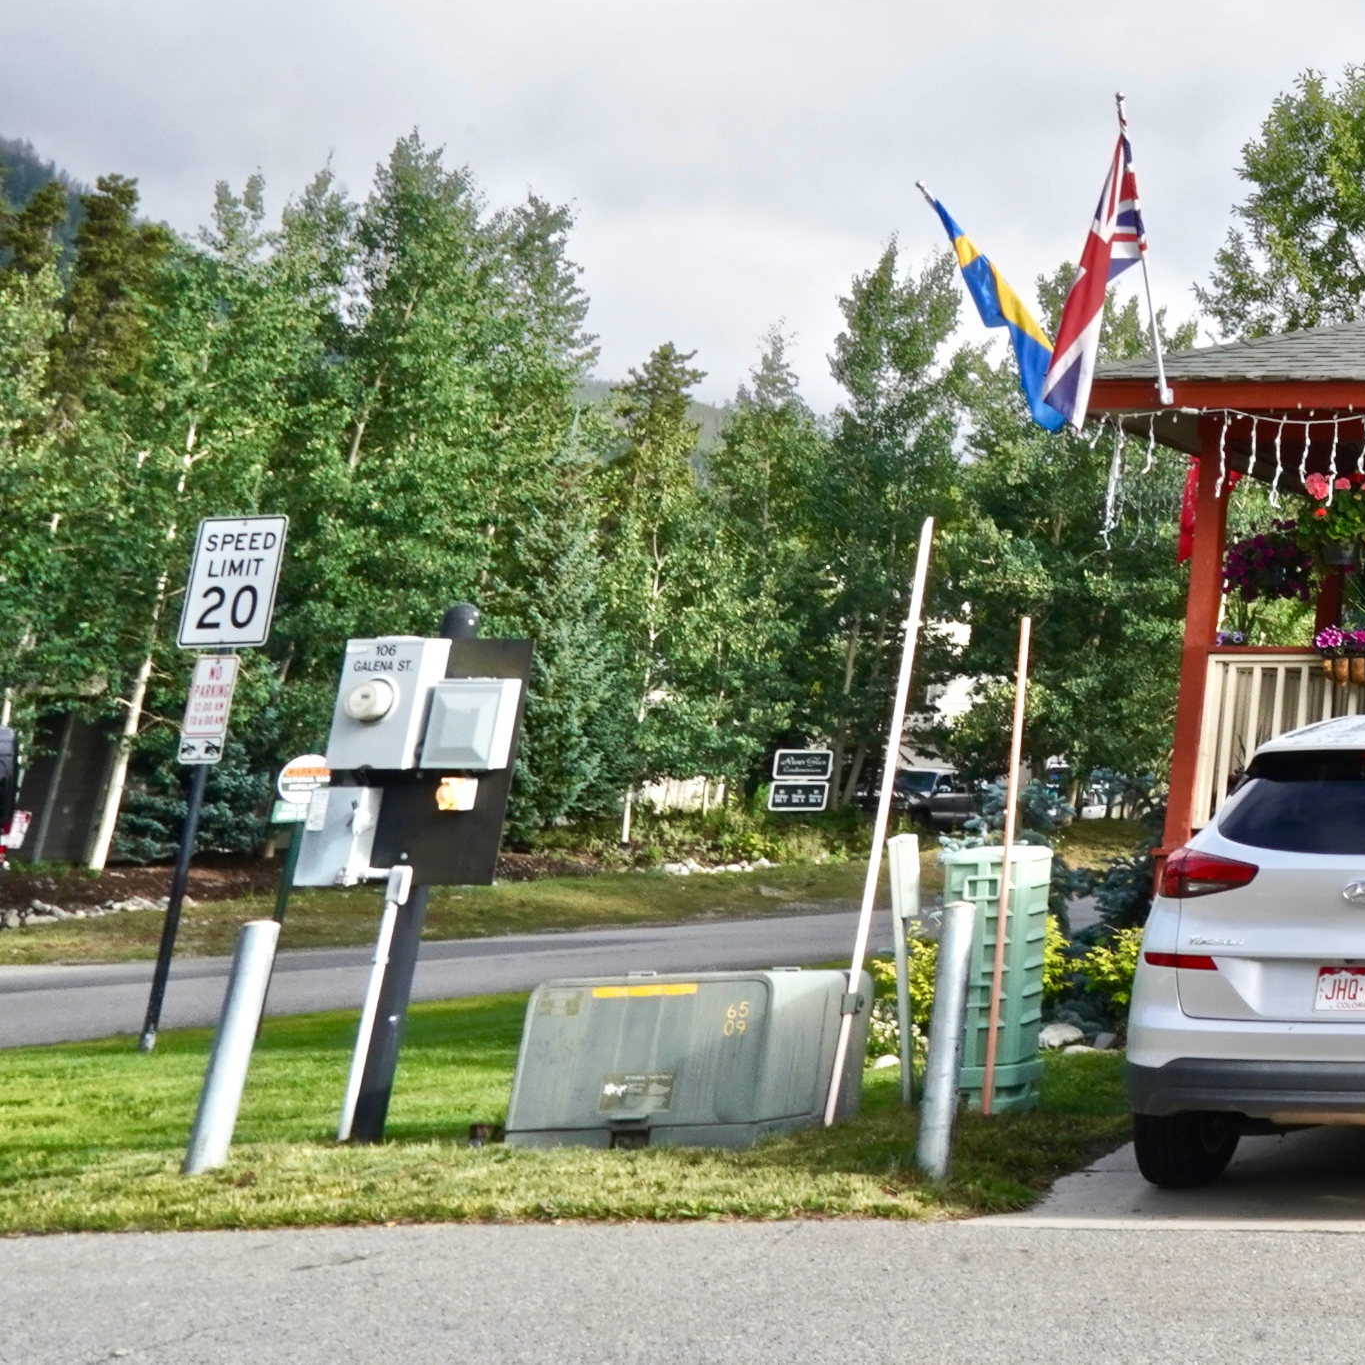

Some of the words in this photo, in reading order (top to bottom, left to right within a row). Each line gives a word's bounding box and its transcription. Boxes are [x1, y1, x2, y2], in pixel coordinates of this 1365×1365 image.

[205, 532, 276, 552] SPEED
[208, 558, 264, 578] LIMIT
[196, 585, 258, 629] 20
[376, 644, 397, 656] 106
[208, 666, 223, 681] NO
[353, 660, 393, 672] GALENA
[397, 659, 413, 672] ST.
[194, 683, 231, 699] PARKING
[726, 1001, 749, 1019] 65
[724, 1020, 747, 1036] 09
